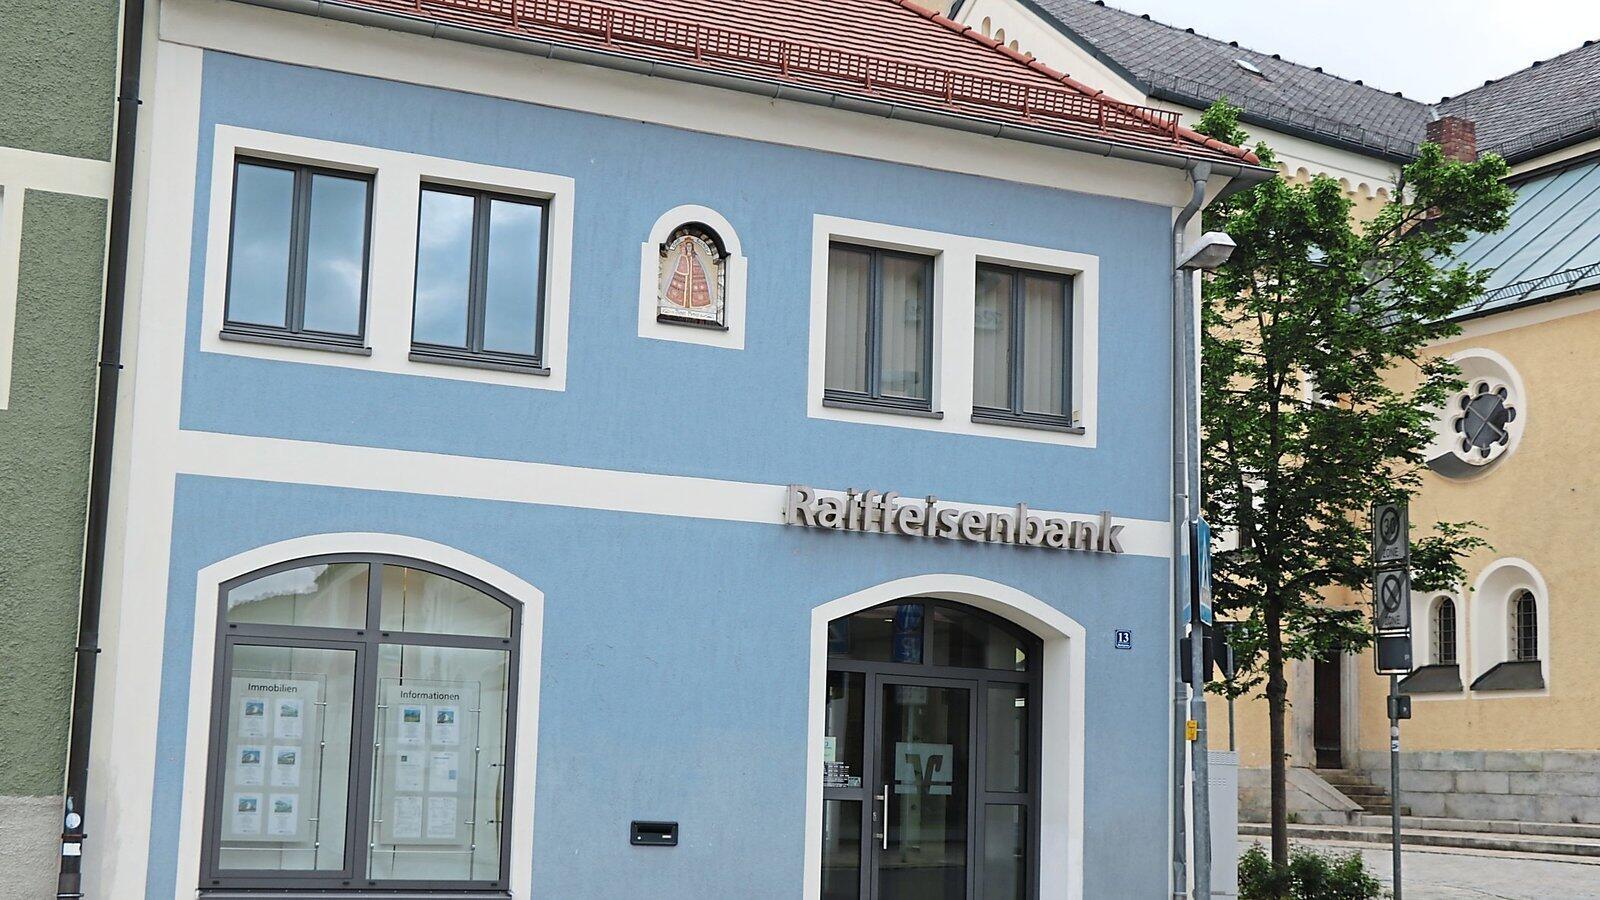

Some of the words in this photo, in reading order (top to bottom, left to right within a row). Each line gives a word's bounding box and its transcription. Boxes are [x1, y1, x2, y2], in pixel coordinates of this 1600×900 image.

[787, 484, 1124, 553] Raiffeisenbank
[1119, 632, 1129, 643] 13
[248, 683, 297, 692] Immobilien
[400, 690, 460, 700] Informationen
